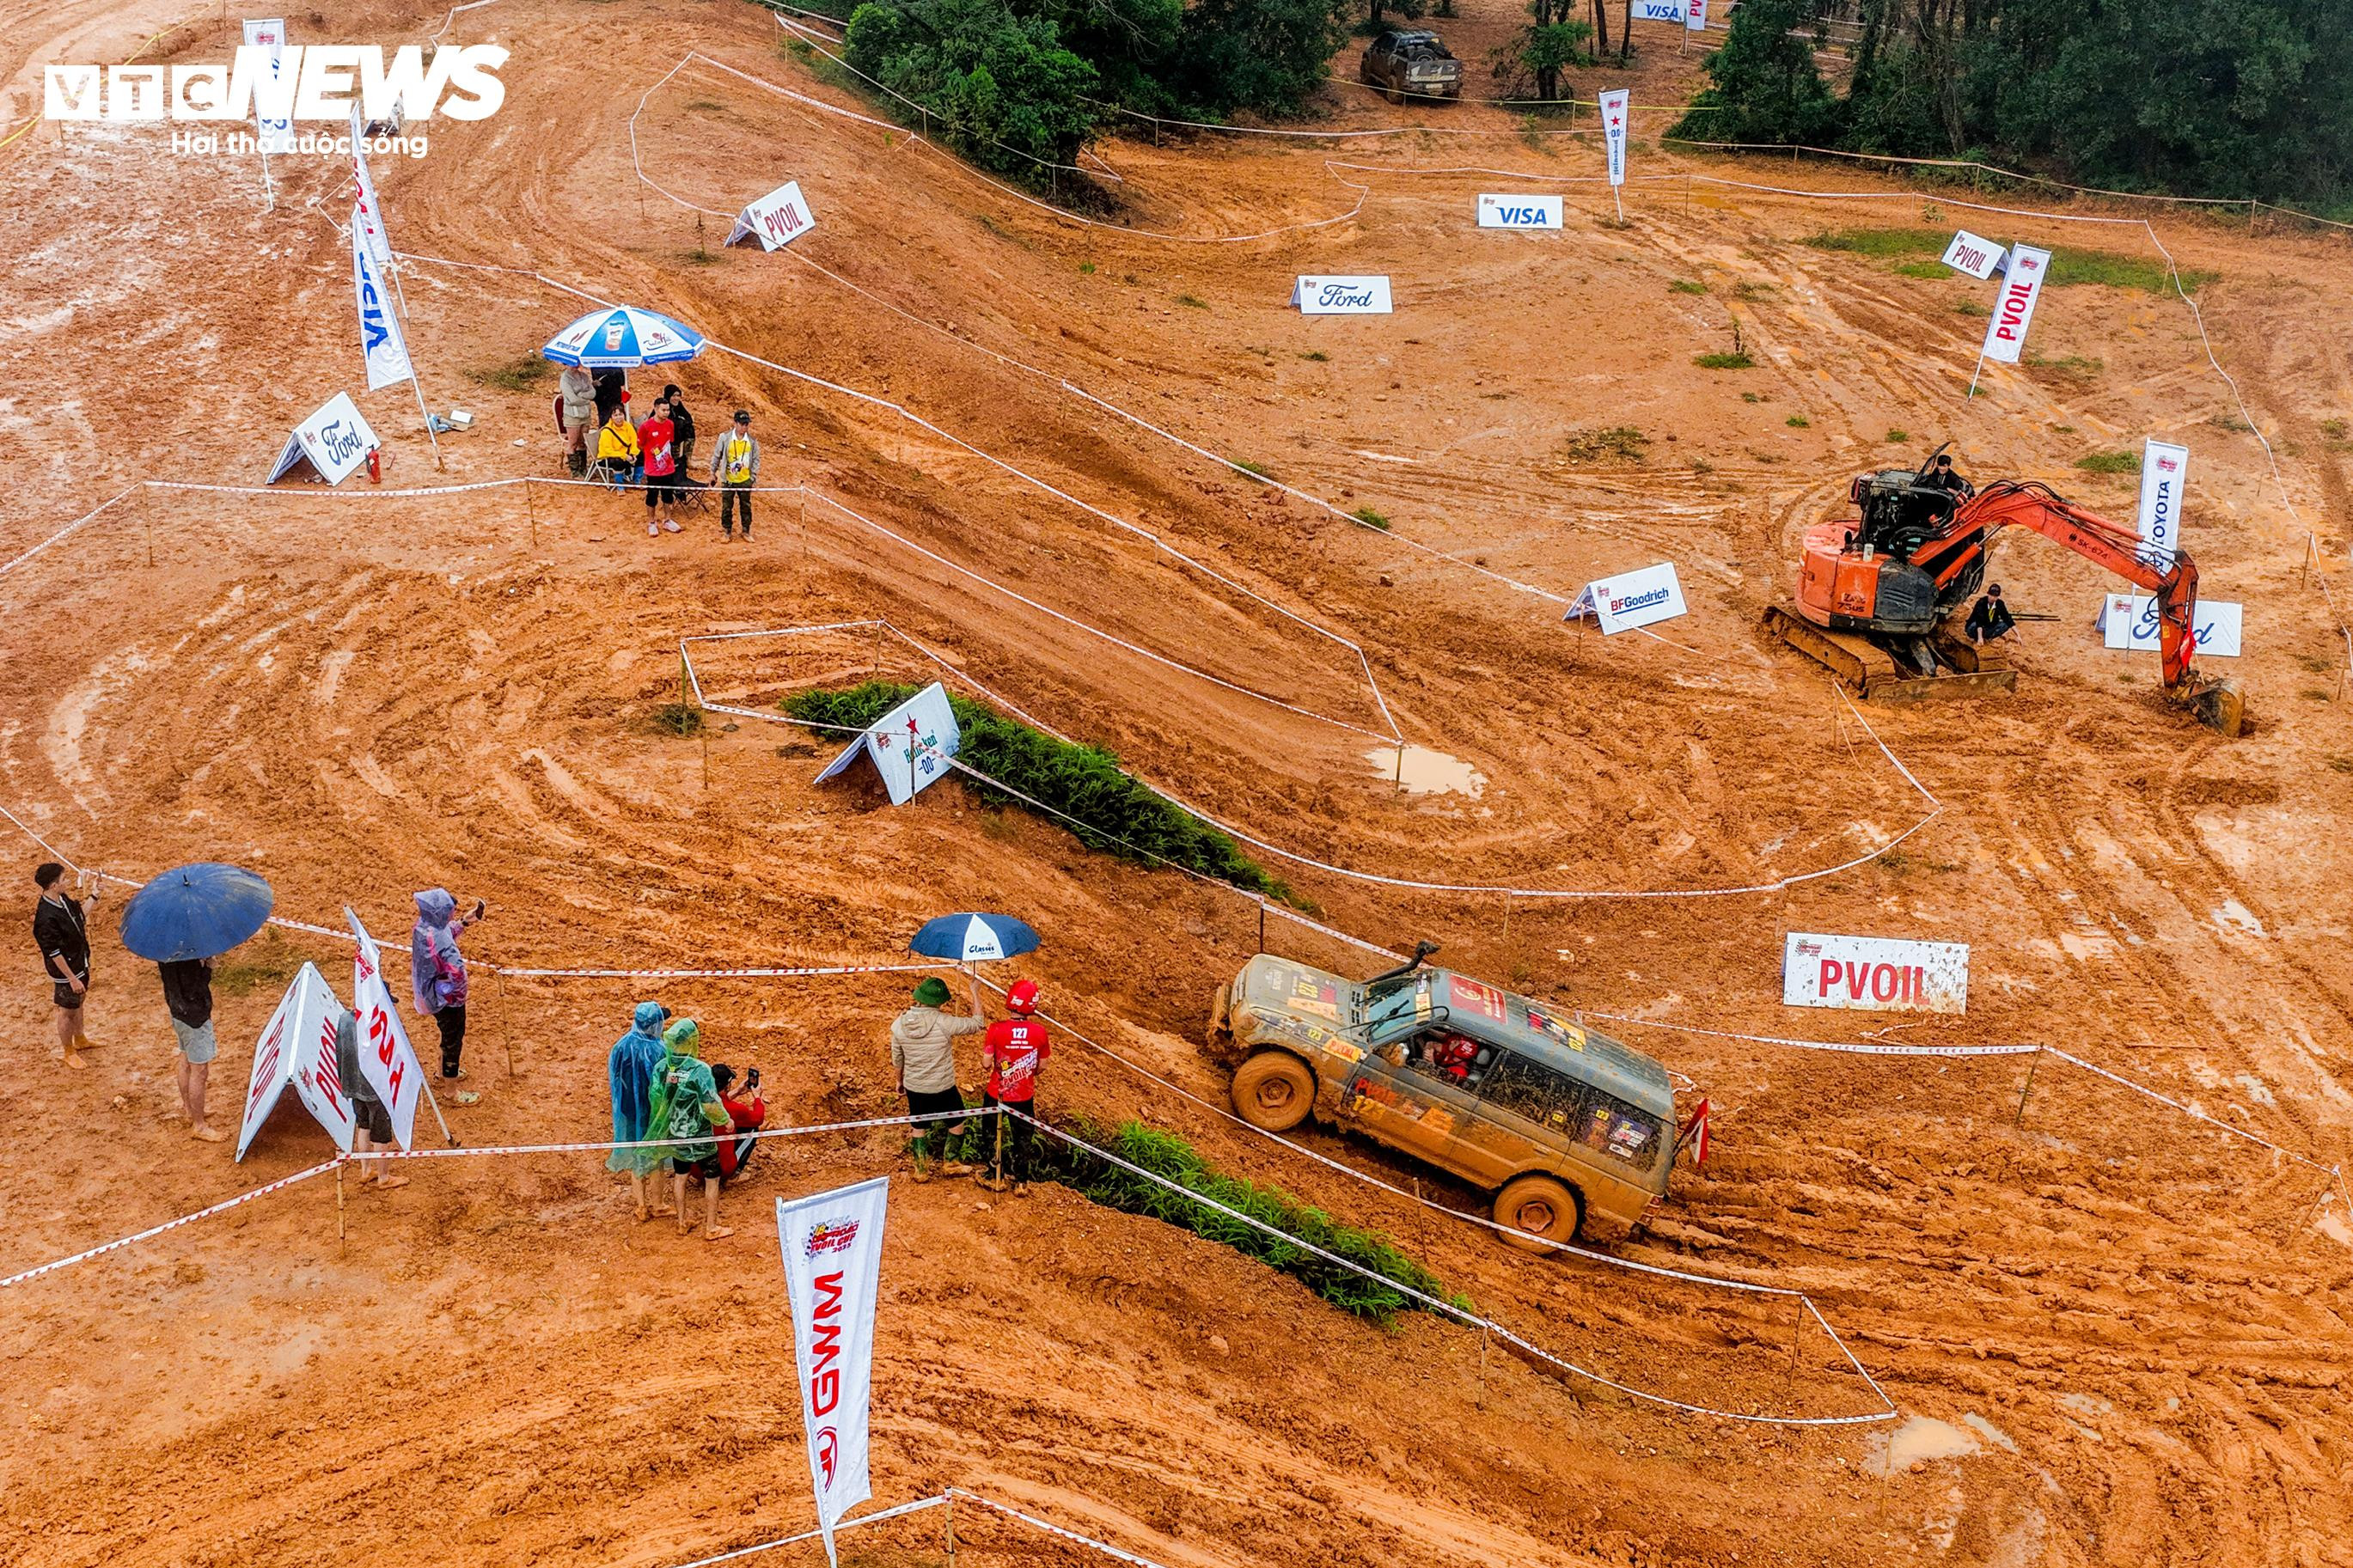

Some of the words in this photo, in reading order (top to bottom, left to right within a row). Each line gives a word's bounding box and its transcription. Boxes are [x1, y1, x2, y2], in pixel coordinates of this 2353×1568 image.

[1645, 3, 1678, 18] VISA
[764, 202, 804, 241] PVOIL
[1495, 206, 1547, 225] VISA
[1952, 244, 1987, 272] PVOIL
[1318, 284, 1373, 307] Ford
[1995, 282, 2033, 341] PVOIL
[321, 419, 363, 466] Ford
[1610, 587, 1669, 612] BFGoodrich
[2132, 609, 2215, 645] Fd
[1818, 959, 1930, 1005] PVOIL
[1011, 1028, 1028, 1039] 127
[811, 1270, 844, 1418] GWM
